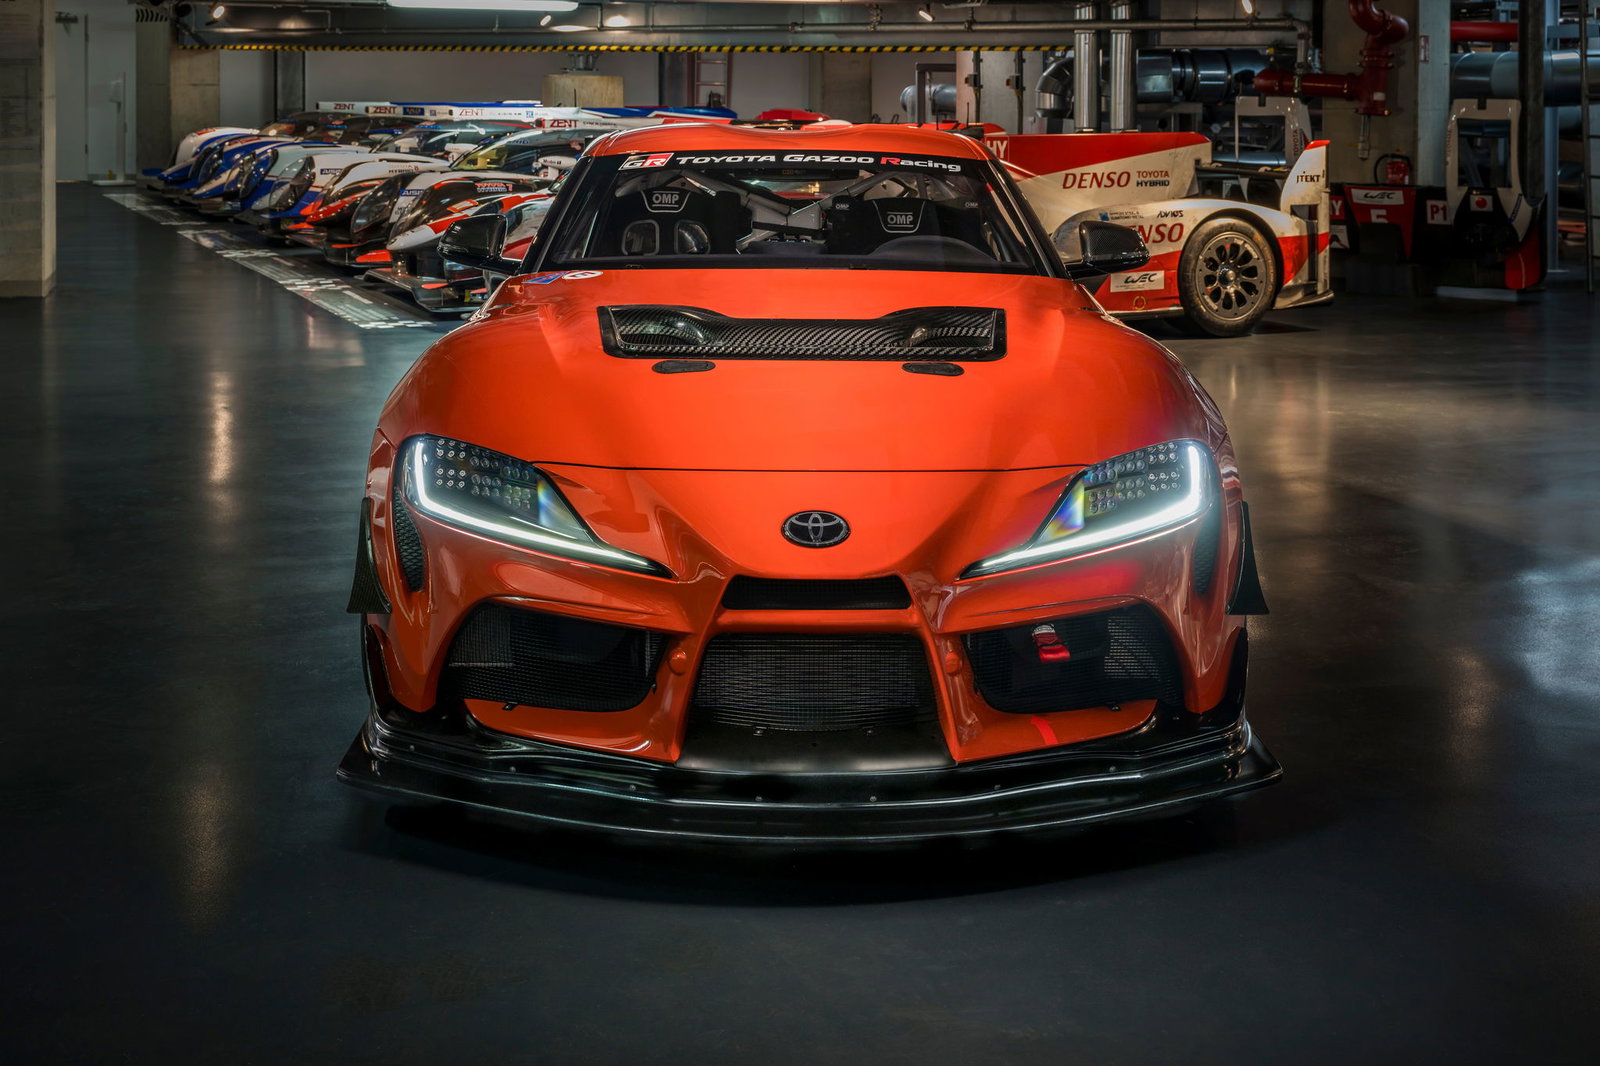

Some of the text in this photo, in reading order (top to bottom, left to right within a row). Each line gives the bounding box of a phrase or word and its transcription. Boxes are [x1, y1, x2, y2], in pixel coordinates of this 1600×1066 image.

[374, 106, 398, 114] ZENT
[550, 119, 579, 128] ZENT
[676, 154, 776, 165] TOYOTA
[783, 154, 875, 164] GAZOO
[880, 156, 962, 173] Racing
[1136, 170, 1170, 179] TOYOTA
[1296, 174, 1321, 184] JTEKT
[1062, 170, 1131, 190] DENSO
[1136, 179, 1170, 188] HYBRID
[652, 193, 680, 205] OMP
[1363, 191, 1397, 200] WEC
[964, 201, 979, 209] OMP
[1429, 203, 1448, 222] P1
[887, 213, 914, 226] OMP
[1123, 272, 1158, 285] WEC
